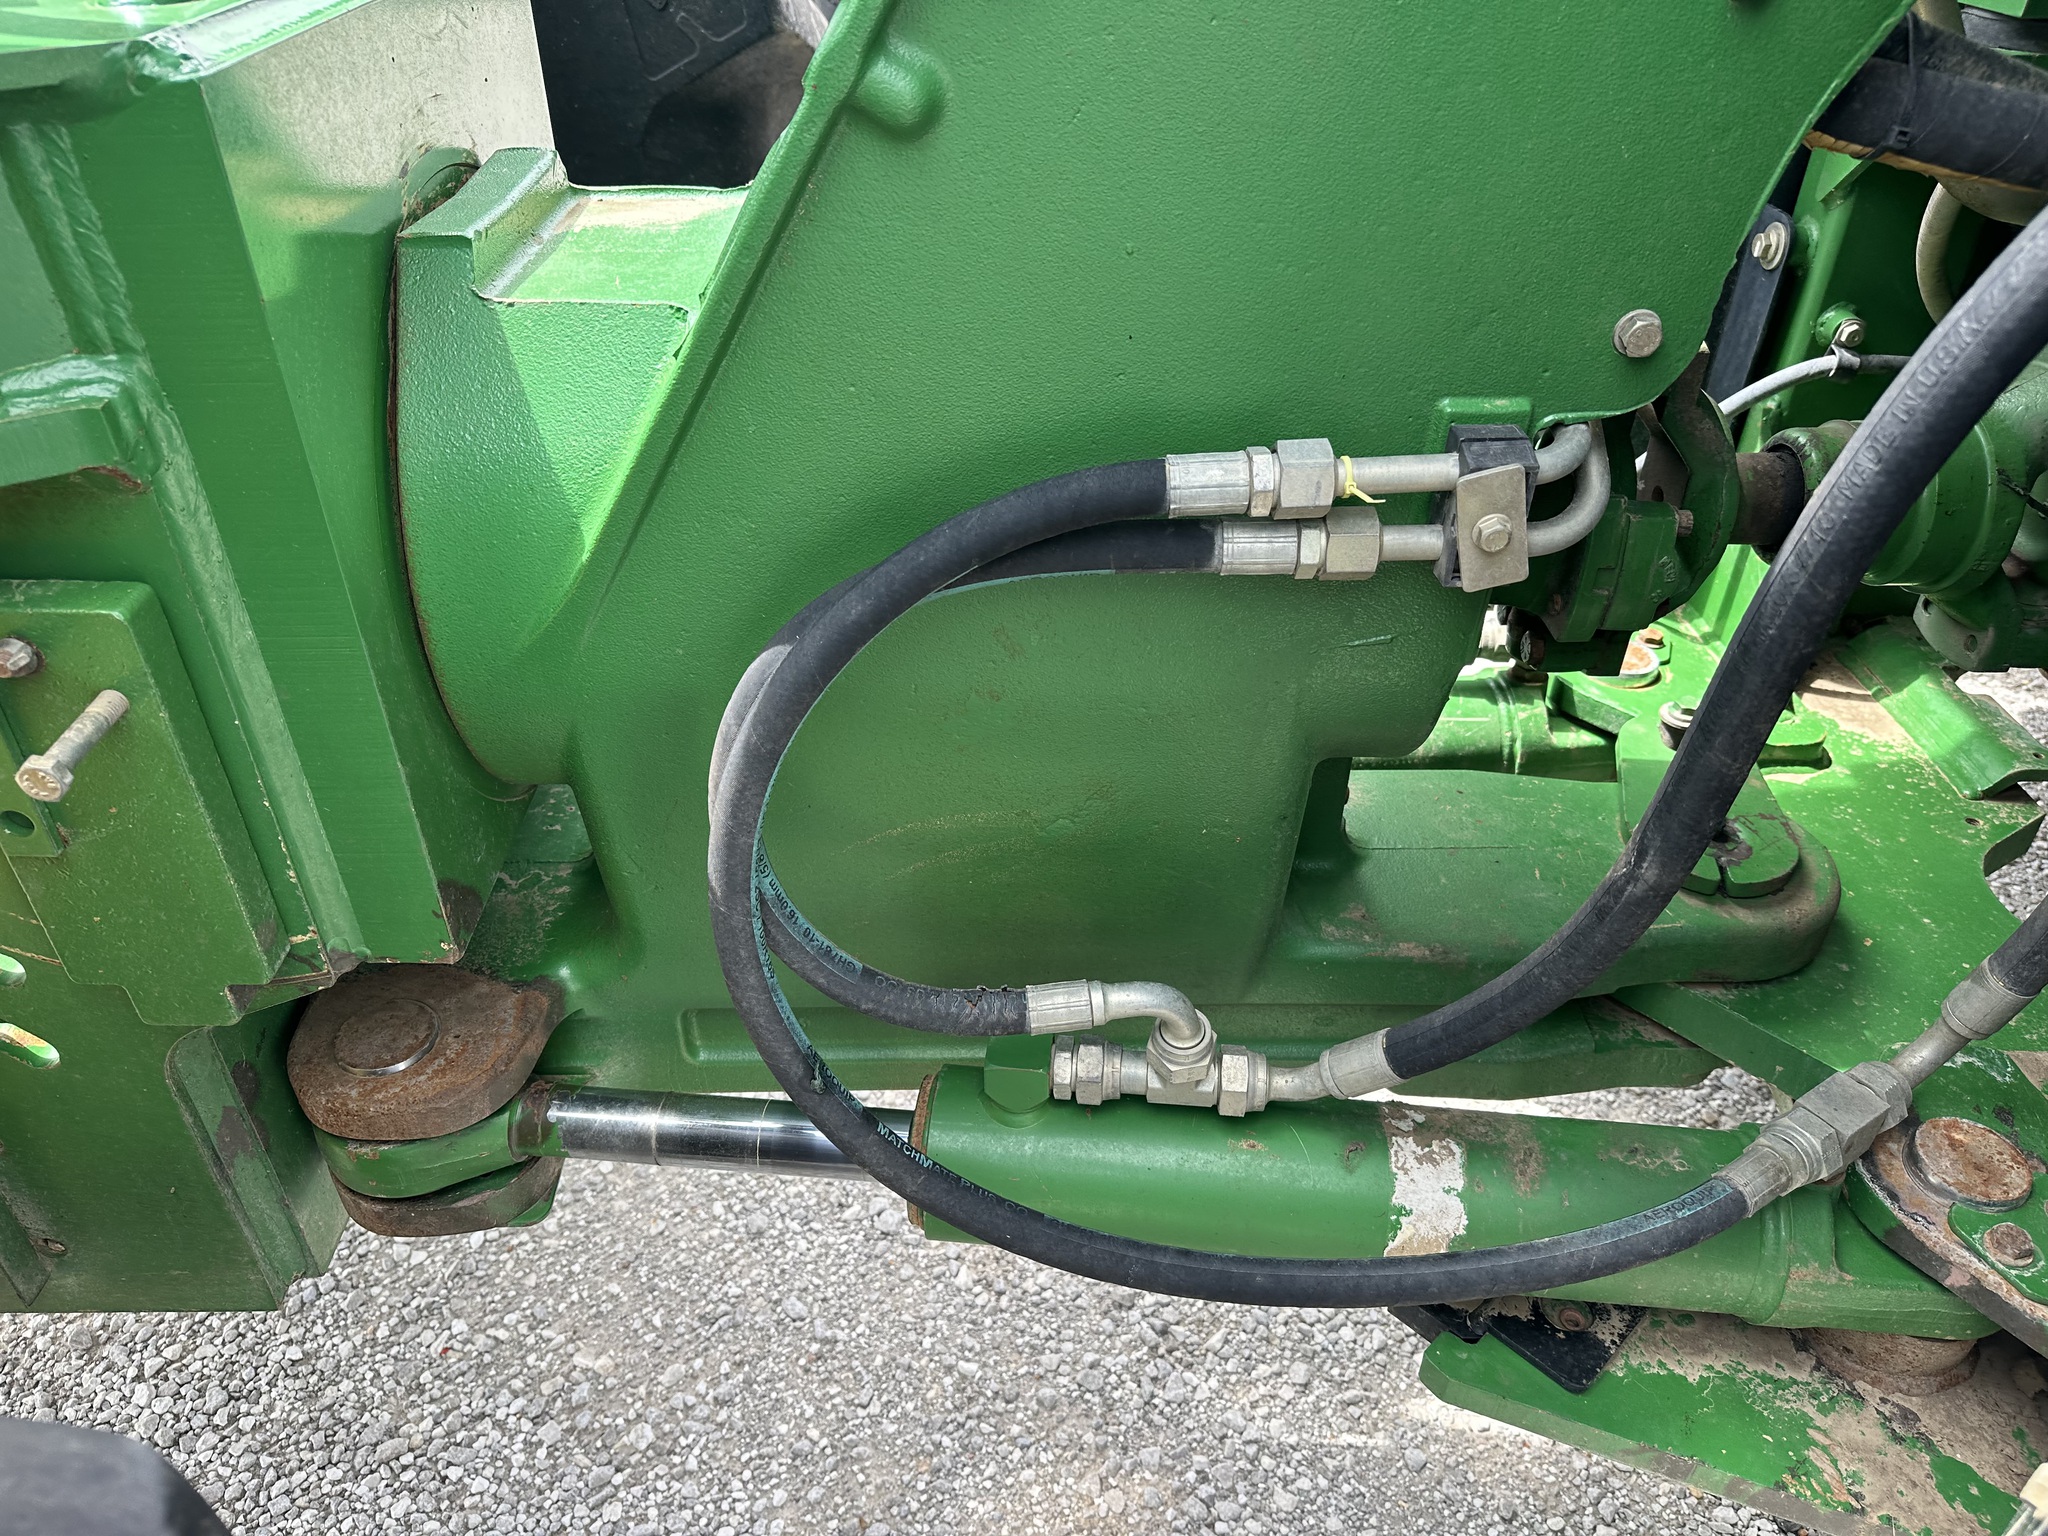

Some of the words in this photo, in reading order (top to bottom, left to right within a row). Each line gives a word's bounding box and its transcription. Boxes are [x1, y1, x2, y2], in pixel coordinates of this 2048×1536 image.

[1837, 425, 1898, 499] MADE
[1891, 389, 1923, 421] IN
[801, 926, 856, 974] GH781-10
[876, 1121, 957, 1184] MATCHMATE
[1643, 1186, 1714, 1223] AEROQUIP
